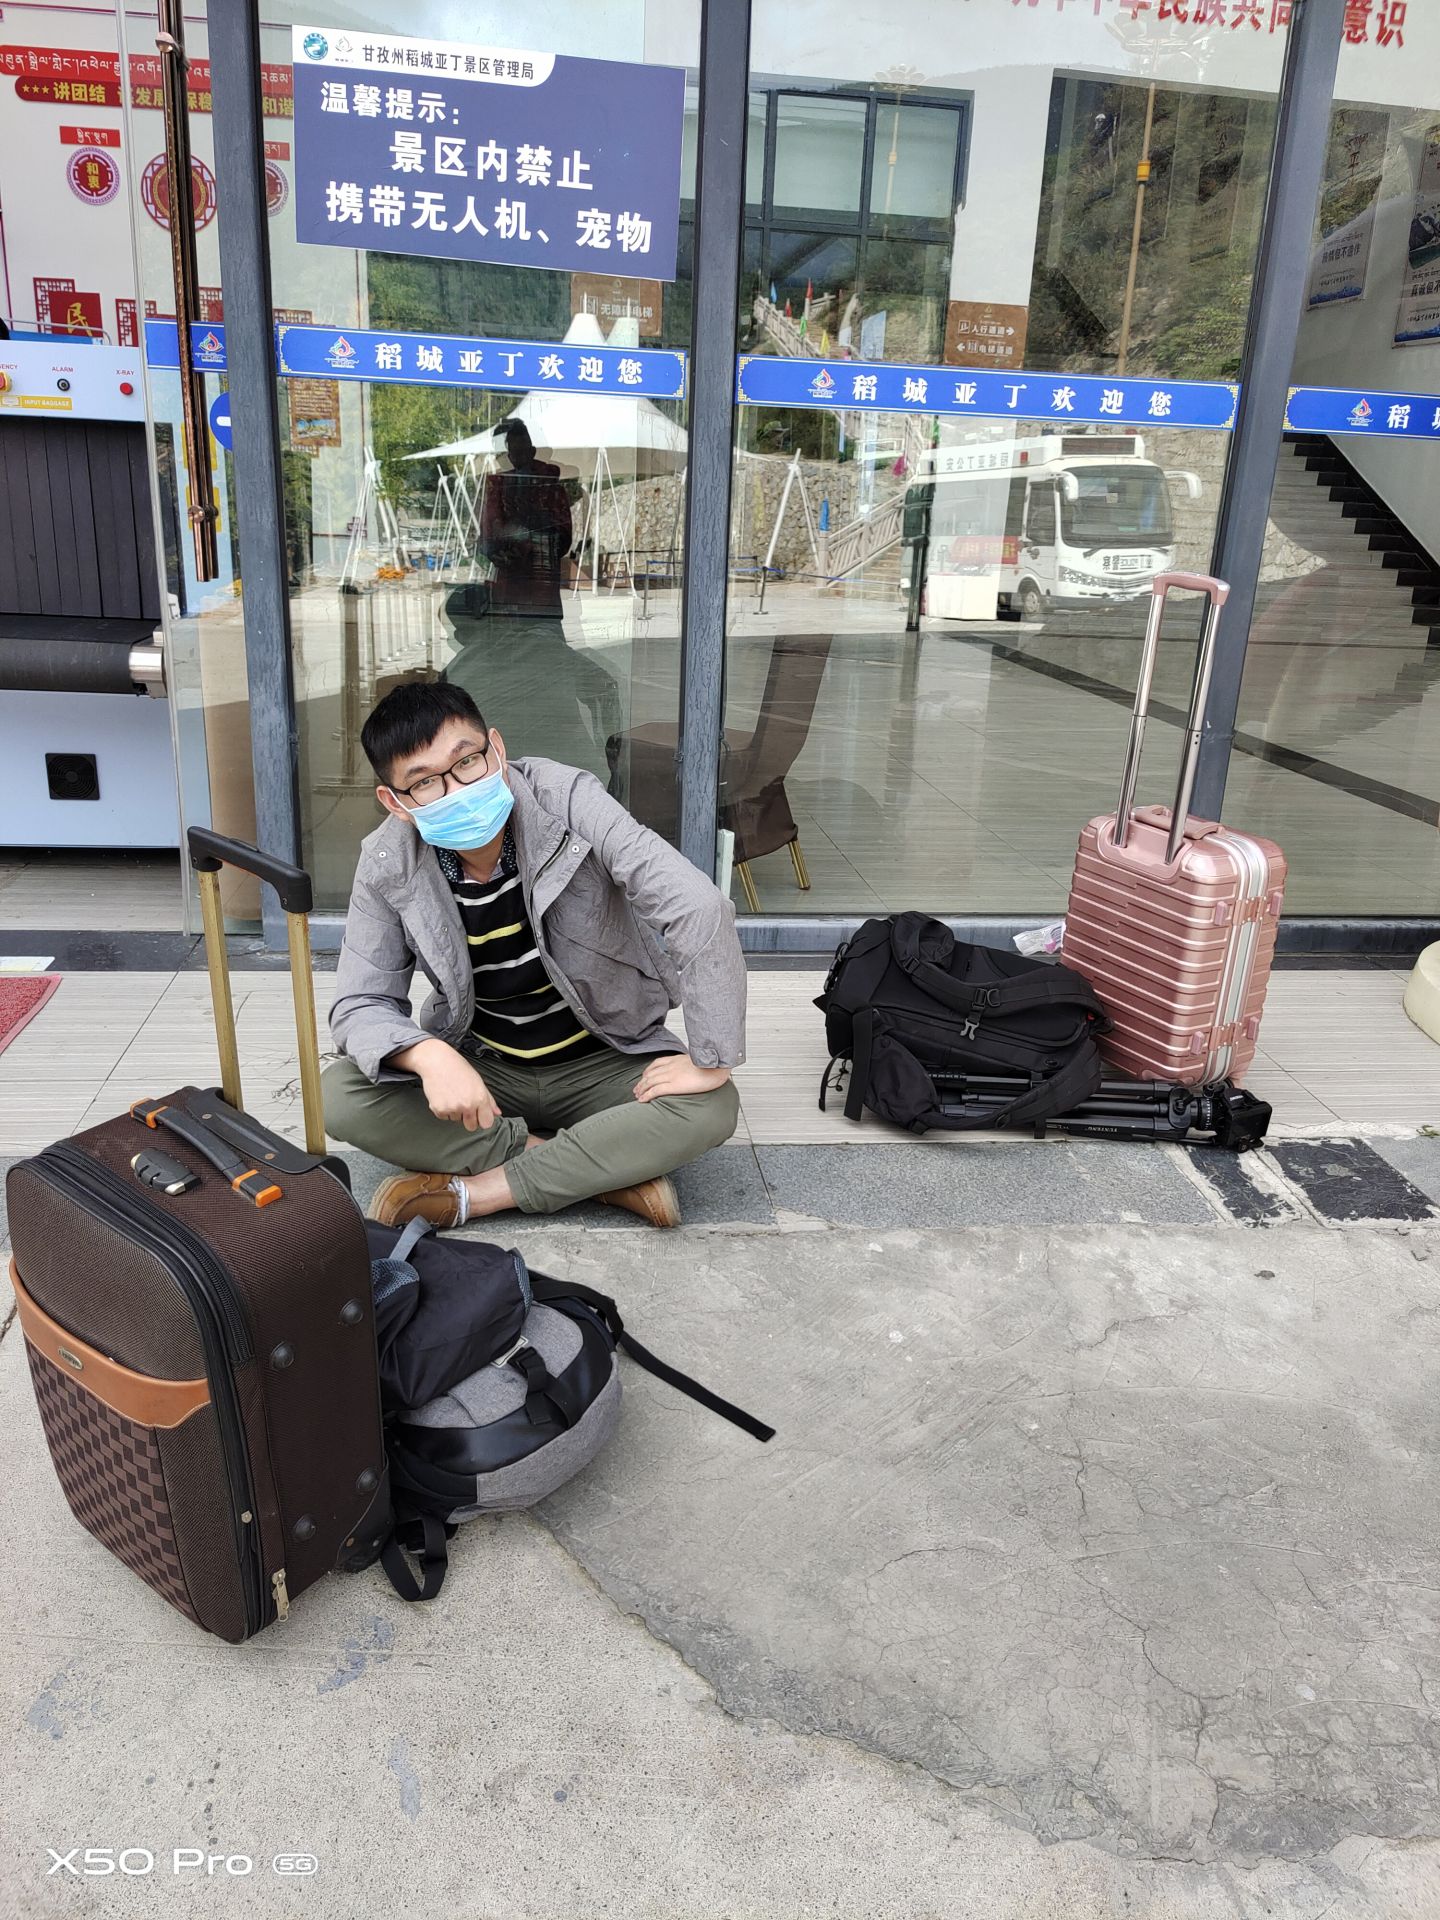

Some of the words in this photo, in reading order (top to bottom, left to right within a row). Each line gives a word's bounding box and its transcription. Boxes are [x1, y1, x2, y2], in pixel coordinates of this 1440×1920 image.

[1340, 0, 1407, 48] 意识
[361, 44, 534, 80] 甘孜州稻城亚丁景区管理局
[53, 81, 106, 103] 讲团结
[389, 130, 594, 191] 景区内禁止
[325, 180, 653, 254] 携带无人机、宠物
[374, 341, 644, 386] 稻城亚丁欢迎您
[851, 373, 1172, 417] 稻城亚丁欢迎您
